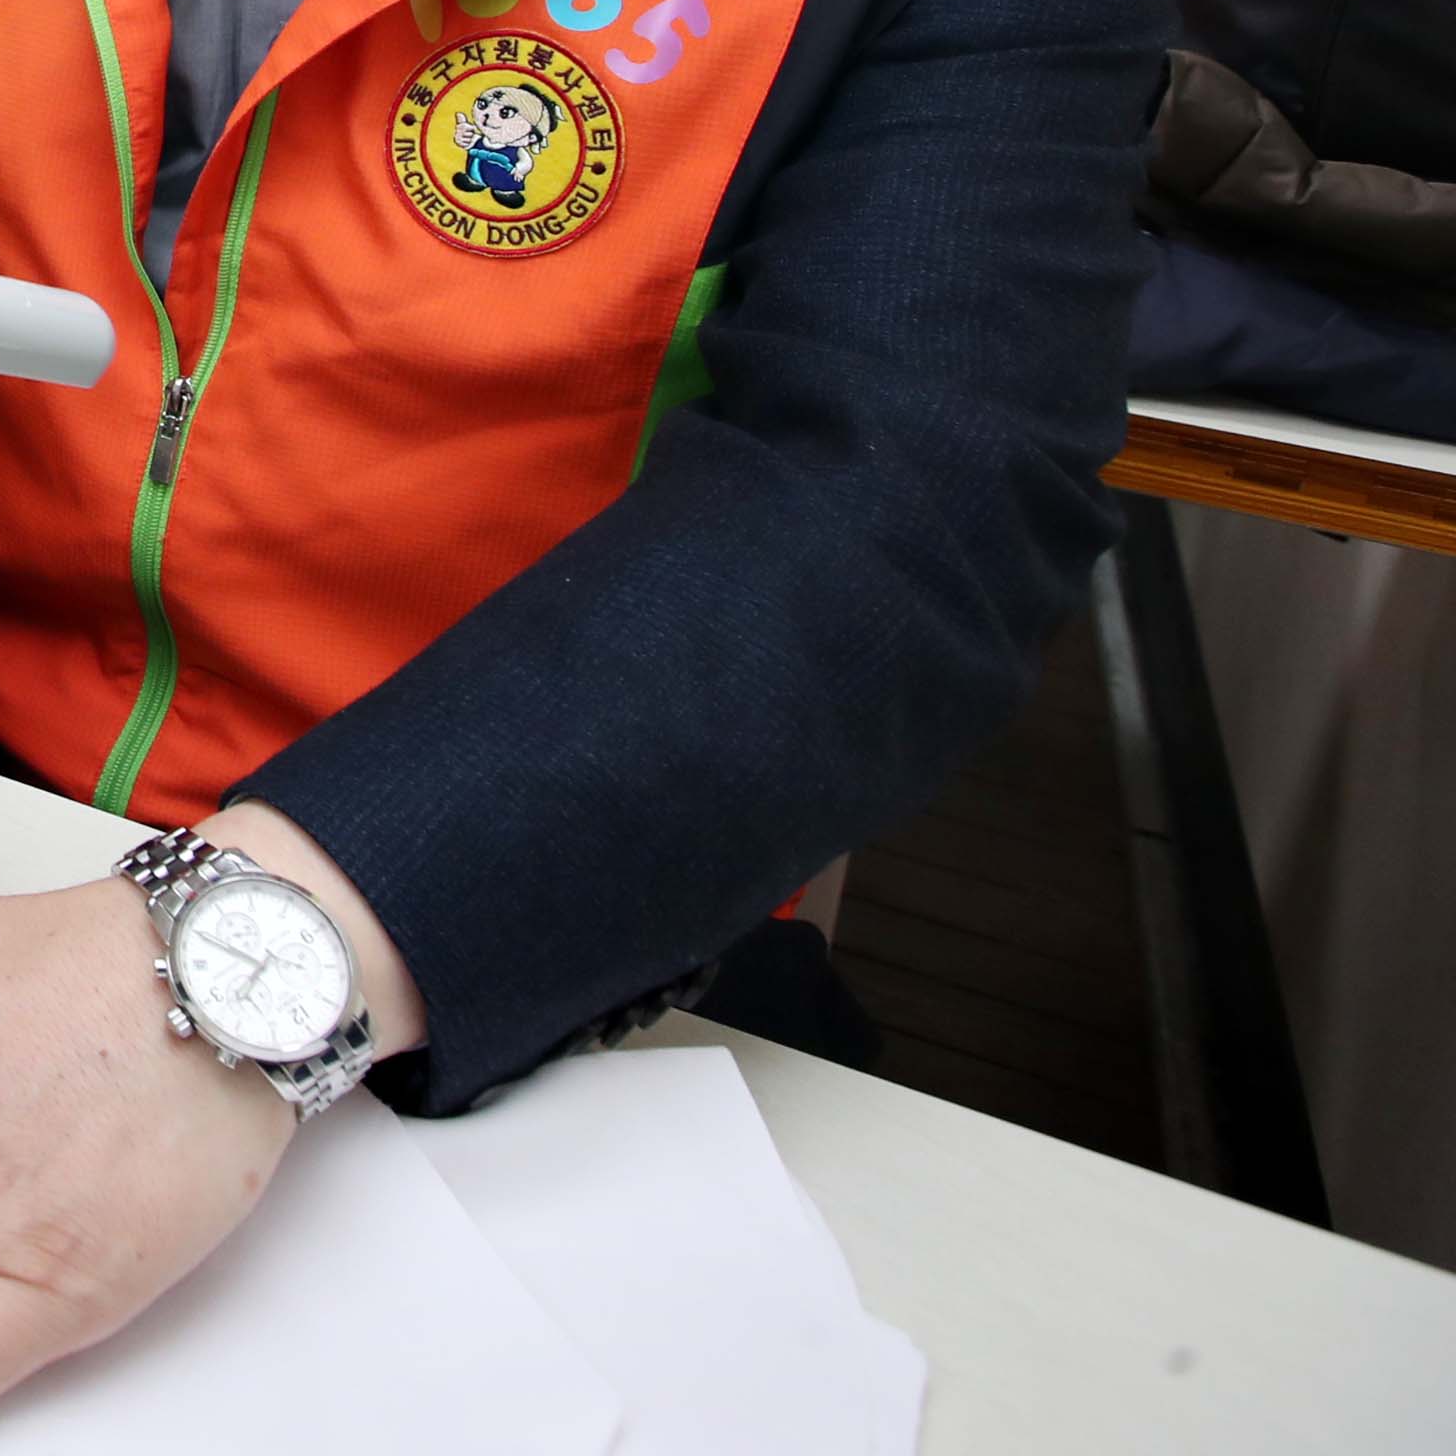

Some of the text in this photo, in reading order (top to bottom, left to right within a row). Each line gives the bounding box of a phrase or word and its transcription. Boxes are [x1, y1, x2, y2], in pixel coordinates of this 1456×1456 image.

[406, 38, 616, 152] 동구자원봉사센터
[394, 137, 601, 246] IN-CHEON DONG-GU
